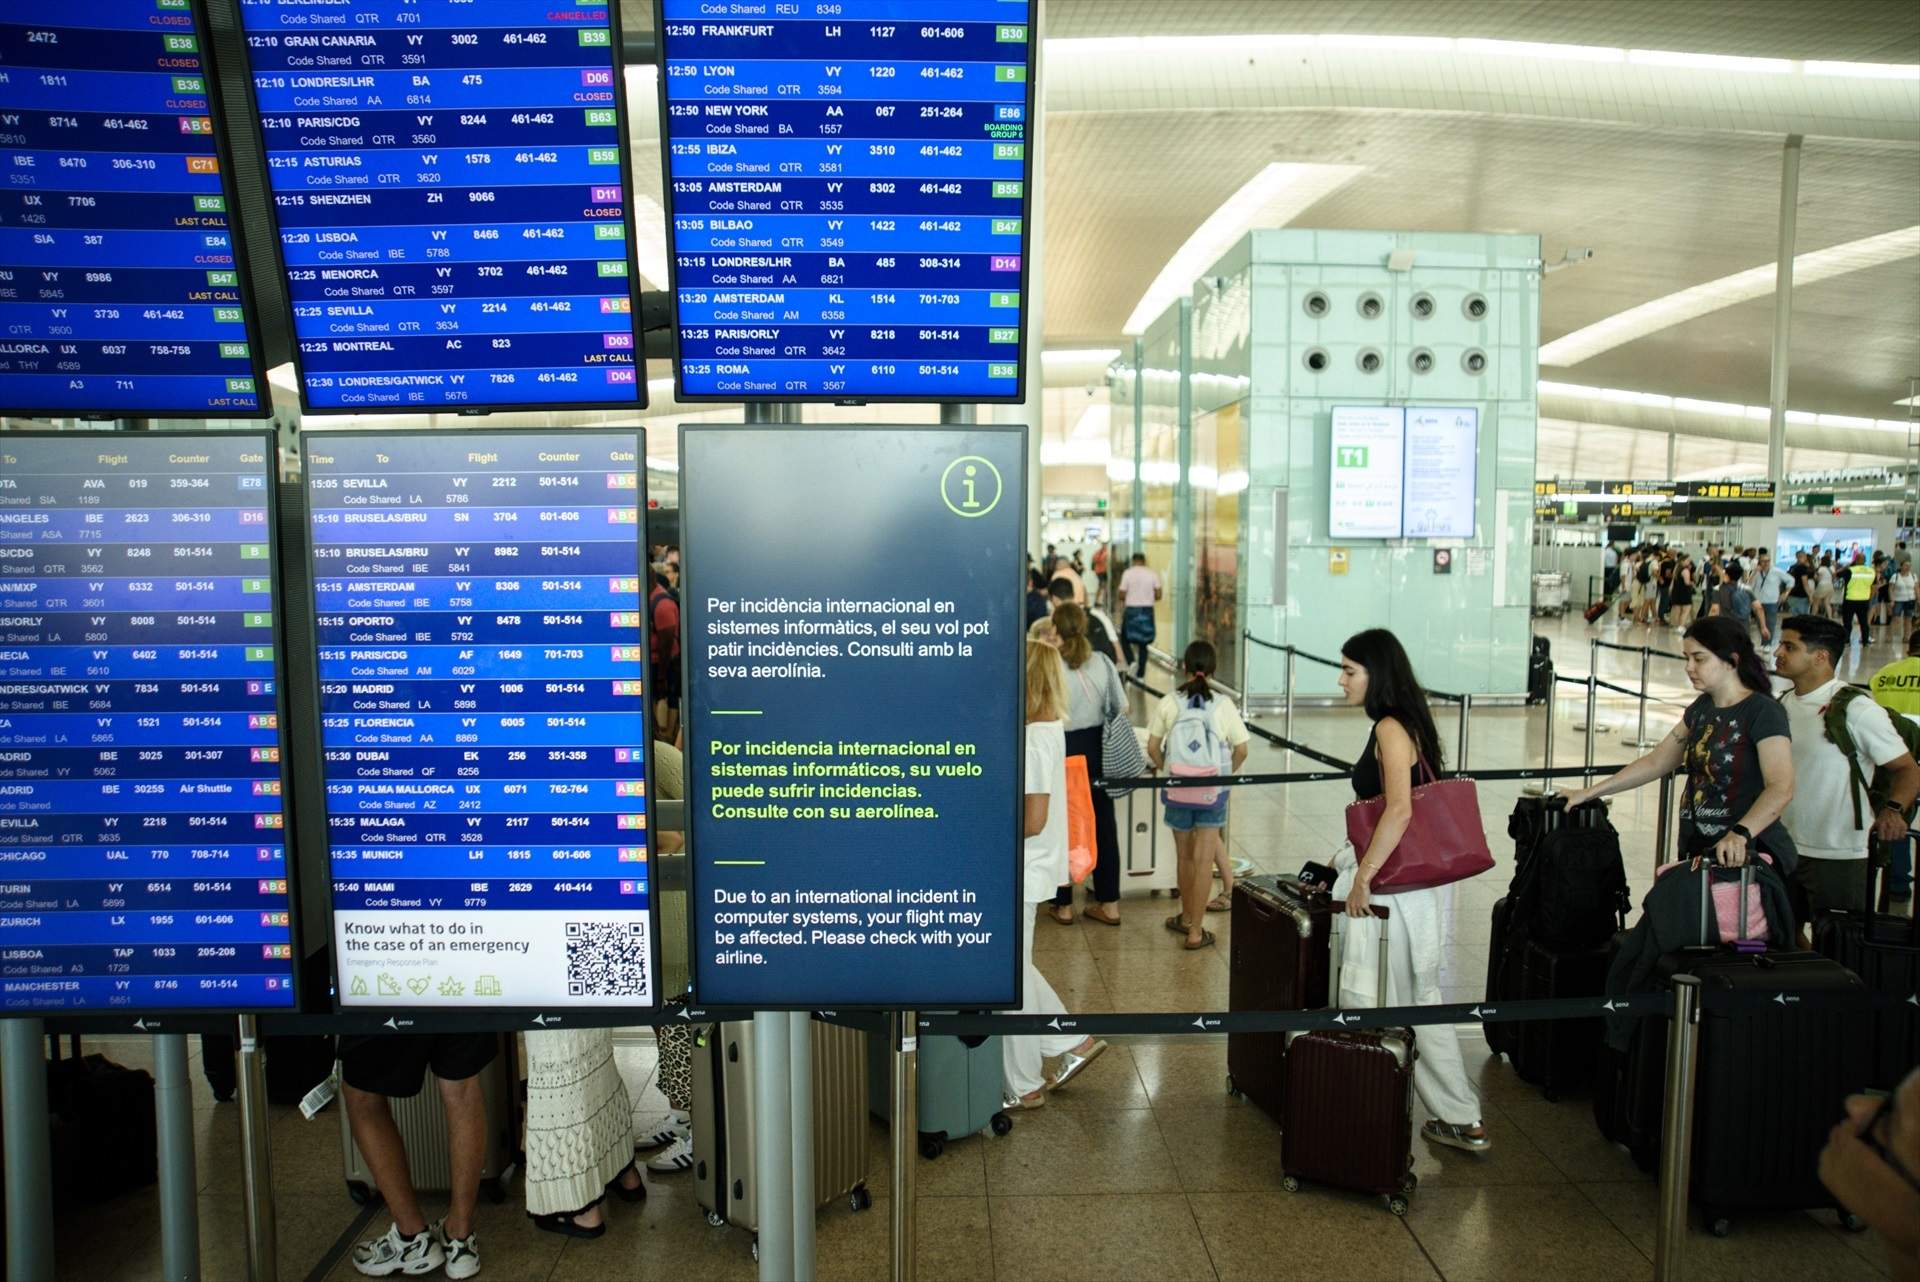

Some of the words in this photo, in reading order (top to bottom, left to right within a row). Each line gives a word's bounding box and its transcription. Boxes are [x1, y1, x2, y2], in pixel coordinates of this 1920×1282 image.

[248, 37, 278, 46] 12:10
[285, 37, 319, 46] GRAN
[322, 36, 376, 46] CANARIA
[407, 35, 423, 45] VY
[452, 35, 478, 44] 3002
[504, 33, 546, 43] 461-462
[584, 32, 605, 43] B39
[664, 26, 695, 37] 12:50
[703, 25, 774, 35] FRANKFURT
[826, 26, 841, 36] LH
[871, 27, 895, 37] 1127
[920, 27, 965, 37] 601-606
[1001, 29, 1022, 39] B30
[28, 32, 57, 43] 2472
[170, 39, 192, 48] B38
[158, 58, 200, 67] CLOSED
[670, 106, 698, 115] 12:50
[706, 105, 734, 115] NEW
[735, 106, 768, 115] YORK
[826, 106, 843, 116] AA
[876, 107, 895, 116] 067
[921, 107, 962, 117] 251-264
[1000, 108, 1020, 118] E86
[706, 124, 731, 133] Code
[735, 124, 768, 133] Shared
[779, 124, 793, 133] BA
[820, 124, 842, 133] 1557
[25, 196, 42, 205] UX
[69, 197, 95, 206] 7706
[199, 199, 220, 208] B62
[276, 196, 304, 205] 12:15
[310, 195, 371, 204] SHENZHEN
[427, 193, 443, 202] ZH
[469, 192, 494, 201] 9066
[597, 190, 616, 199] D11
[584, 208, 621, 217] CLOSED
[202, 218, 226, 226] CALL
[678, 257, 705, 266] 13:15
[711, 256, 791, 268] LONDRES/LHR
[829, 258, 845, 267] BA
[876, 258, 895, 267] 485
[920, 258, 960, 267] 308-314
[996, 259, 1016, 268] D14
[301, 343, 327, 352] 12:25
[333, 342, 394, 351] MONTREAL
[446, 340, 461, 349] AC
[493, 339, 510, 348] 823
[609, 337, 629, 345] D03
[4, 456, 16, 464] To
[99, 455, 128, 465] Flight
[170, 455, 210, 464] Counter
[240, 454, 264, 463] Gate
[310, 455, 334, 463] Time
[376, 455, 389, 463] To
[469, 453, 497, 464] Flight
[539, 453, 580, 461] Counter
[611, 452, 634, 462] Gate
[1341, 449, 1364, 465] T1
[312, 480, 337, 488] 15:05
[343, 479, 387, 488] SEVILLA
[453, 478, 467, 487] VY
[492, 477, 518, 487] 2212
[540, 477, 578, 487] 501-514
[708, 598, 736, 612] Per
[741, 598, 822, 613] incidència
[827, 598, 930, 613] internacional
[935, 602, 954, 613] en
[708, 620, 779, 634] sistemes
[785, 620, 877, 636] informàtics,
[882, 620, 895, 634] el
[901, 623, 930, 634] seu
[935, 620, 958, 634] vol
[964, 621, 989, 638] pot
[709, 642, 744, 659] patir
[748, 642, 843, 656] incidències.
[848, 642, 913, 656] Consulti
[919, 642, 953, 656] amb
[959, 642, 972, 656] la
[709, 666, 747, 677] seva
[752, 663, 825, 677] aerolínia.
[711, 741, 741, 755] Por
[746, 741, 833, 755] incidencia
[839, 741, 950, 755] internacional
[955, 744, 975, 755] en
[712, 762, 787, 776] sistemas
[793, 762, 905, 778] informáticos,
[910, 766, 930, 776] su
[936, 762, 982, 776] vuelo
[327, 785, 352, 794] 15:30
[358, 784, 395, 795] PALMA
[396, 785, 454, 794] MALLORCA
[466, 785, 480, 794] UX
[504, 784, 526, 793] 6071
[550, 784, 588, 793] 762-764
[712, 784, 764, 800] puede
[769, 784, 815, 797] sufrir
[820, 784, 921, 797] incidencias.
[712, 804, 788, 818] Consulte
[793, 808, 824, 818] con
[830, 808, 850, 818] su
[856, 804, 938, 818] aerolínea.
[715, 889, 746, 903] Due
[751, 890, 766, 903] to
[771, 893, 790, 903] an
[796, 890, 892, 903] international
[897, 889, 958, 903] incident
[963, 889, 975, 902] in
[0, 918, 40, 926] ZURICH
[112, 916, 125, 924] LX
[151, 914, 174, 924] 1955
[195, 916, 233, 924] 601-606
[715, 911, 789, 926] computer
[793, 911, 862, 927] systems,
[867, 913, 902, 927] your
[906, 910, 944, 927] flight
[949, 912, 982, 926] may
[345, 923, 384, 934] Know
[390, 923, 425, 934] what
[430, 924, 444, 934] to
[449, 923, 465, 934] do
[471, 922, 483, 934] in
[346, 939, 369, 950] the
[374, 942, 405, 951] case
[411, 938, 425, 951] of
[429, 942, 445, 950] an
[450, 942, 529, 953] emergency
[716, 931, 734, 944] be
[740, 930, 807, 944] affected.
[812, 931, 865, 944] Please
[870, 930, 917, 944] check
[921, 930, 952, 944] with
[957, 933, 992, 947] your
[716, 950, 767, 964] airline.
